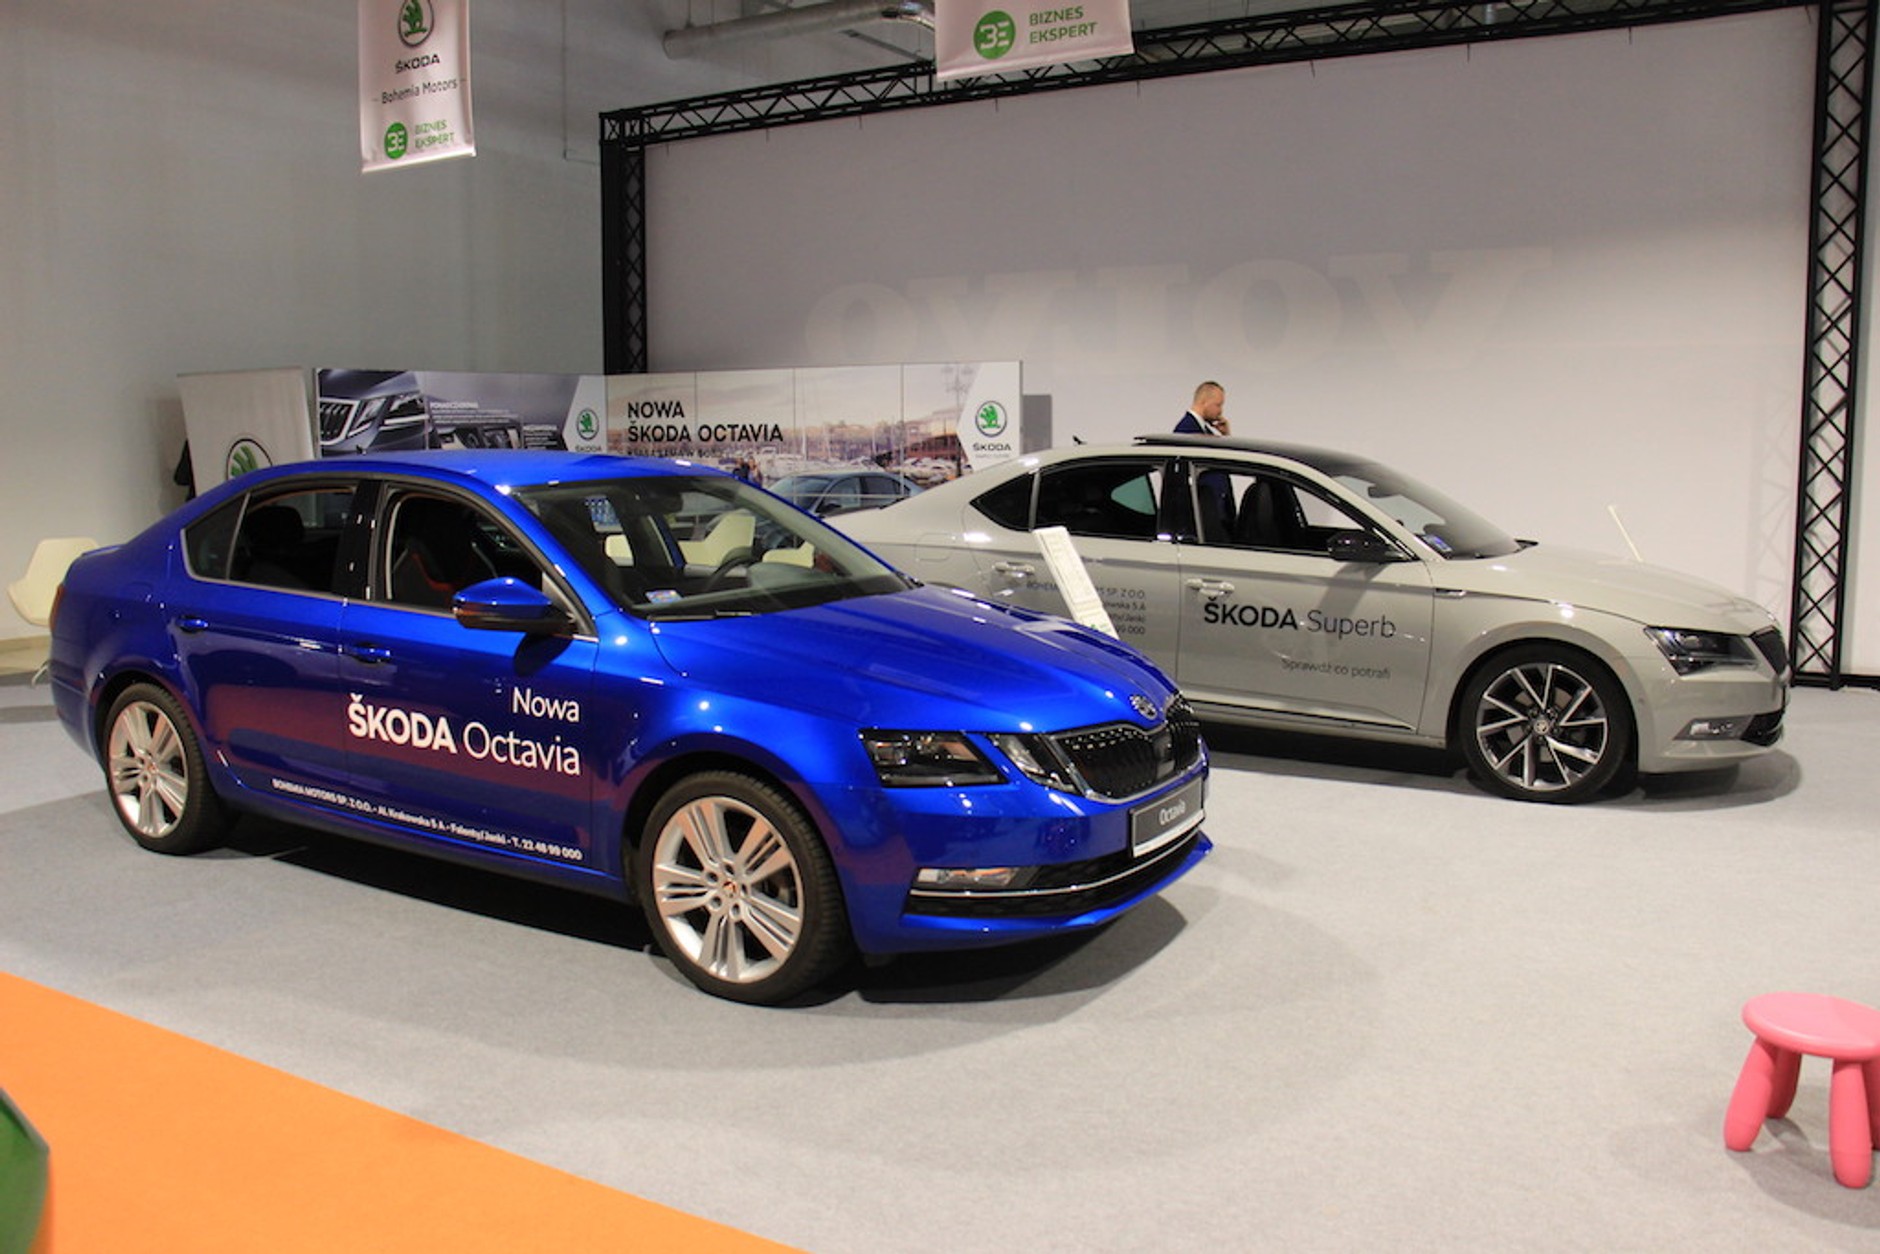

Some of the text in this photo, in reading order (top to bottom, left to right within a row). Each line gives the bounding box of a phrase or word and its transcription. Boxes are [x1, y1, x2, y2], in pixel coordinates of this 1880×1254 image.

[1029, 6, 1084, 26] BIZNES
[1029, 22, 1098, 44] EKSPERT
[382, 78, 458, 104] Bohemia Motors
[415, 120, 447, 135] BIZNES
[415, 132, 454, 149] EKSPERT
[628, 401, 685, 419] NOWA
[628, 421, 784, 442] ŠKODA OCTAVIA
[1204, 596, 1397, 640] ŠKODA Superb
[1333, 665, 1349, 676] co
[512, 686, 580, 723] Nowa
[348, 693, 581, 775] ŠKODA Octavia
[1158, 800, 1187, 825] Octavia
[561, 846, 582, 861] 000
